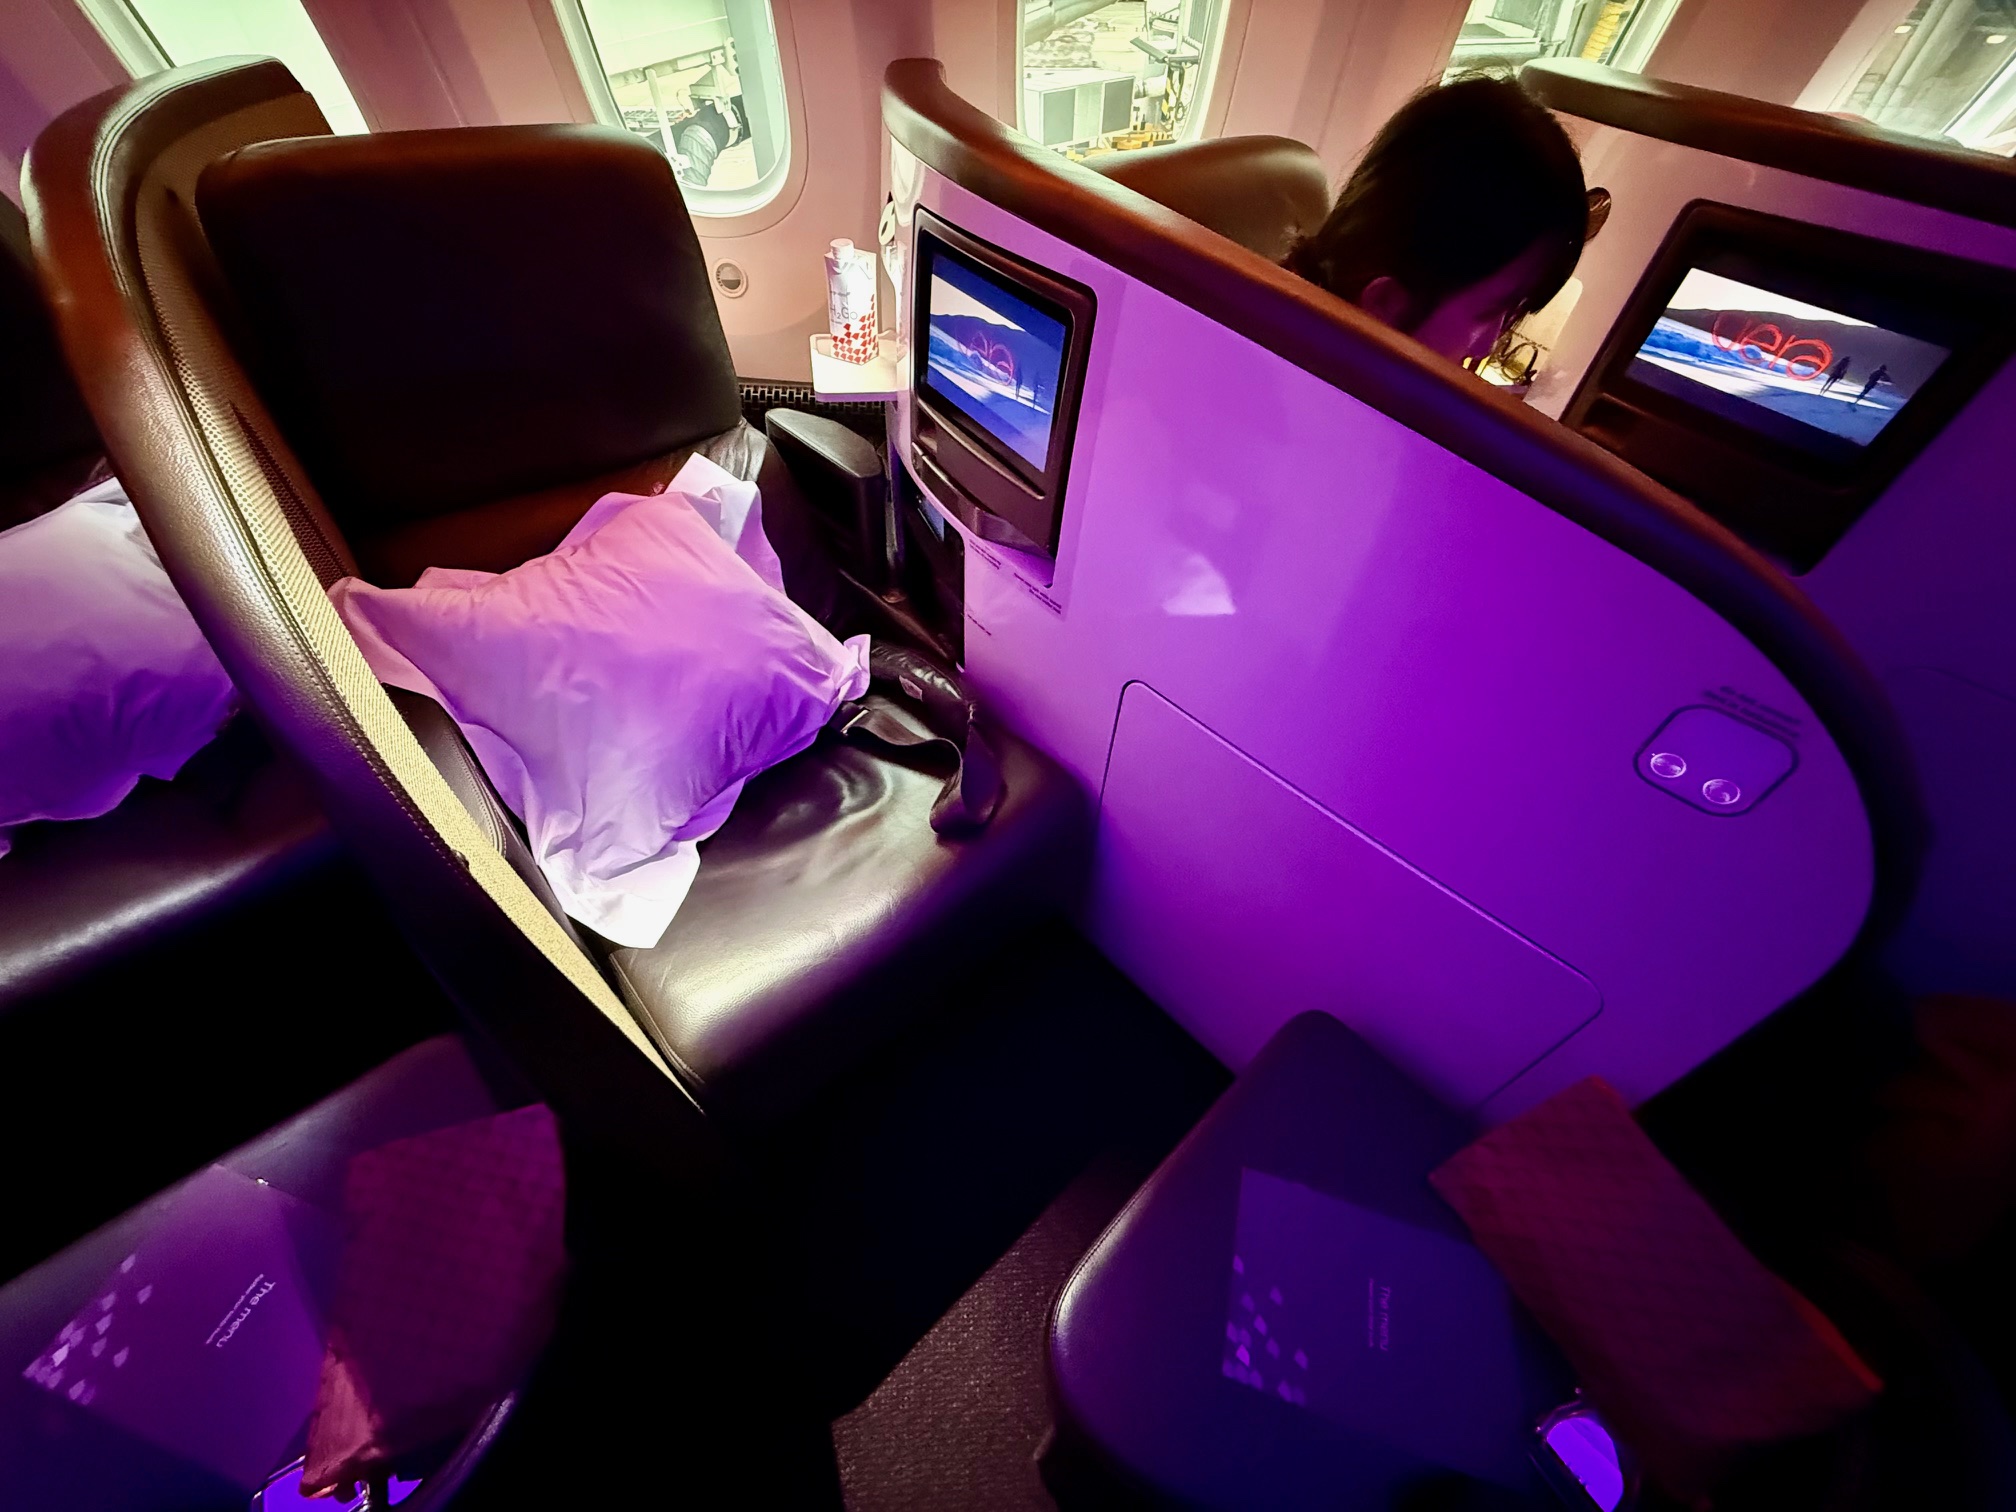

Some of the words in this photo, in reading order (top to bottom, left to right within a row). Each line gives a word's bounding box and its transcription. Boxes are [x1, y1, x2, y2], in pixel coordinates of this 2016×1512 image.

[249, 1282, 276, 1306] The
[1380, 1286, 1391, 1309] The
[216, 1307, 251, 1348] menu
[1379, 1312, 1388, 1351] menu
